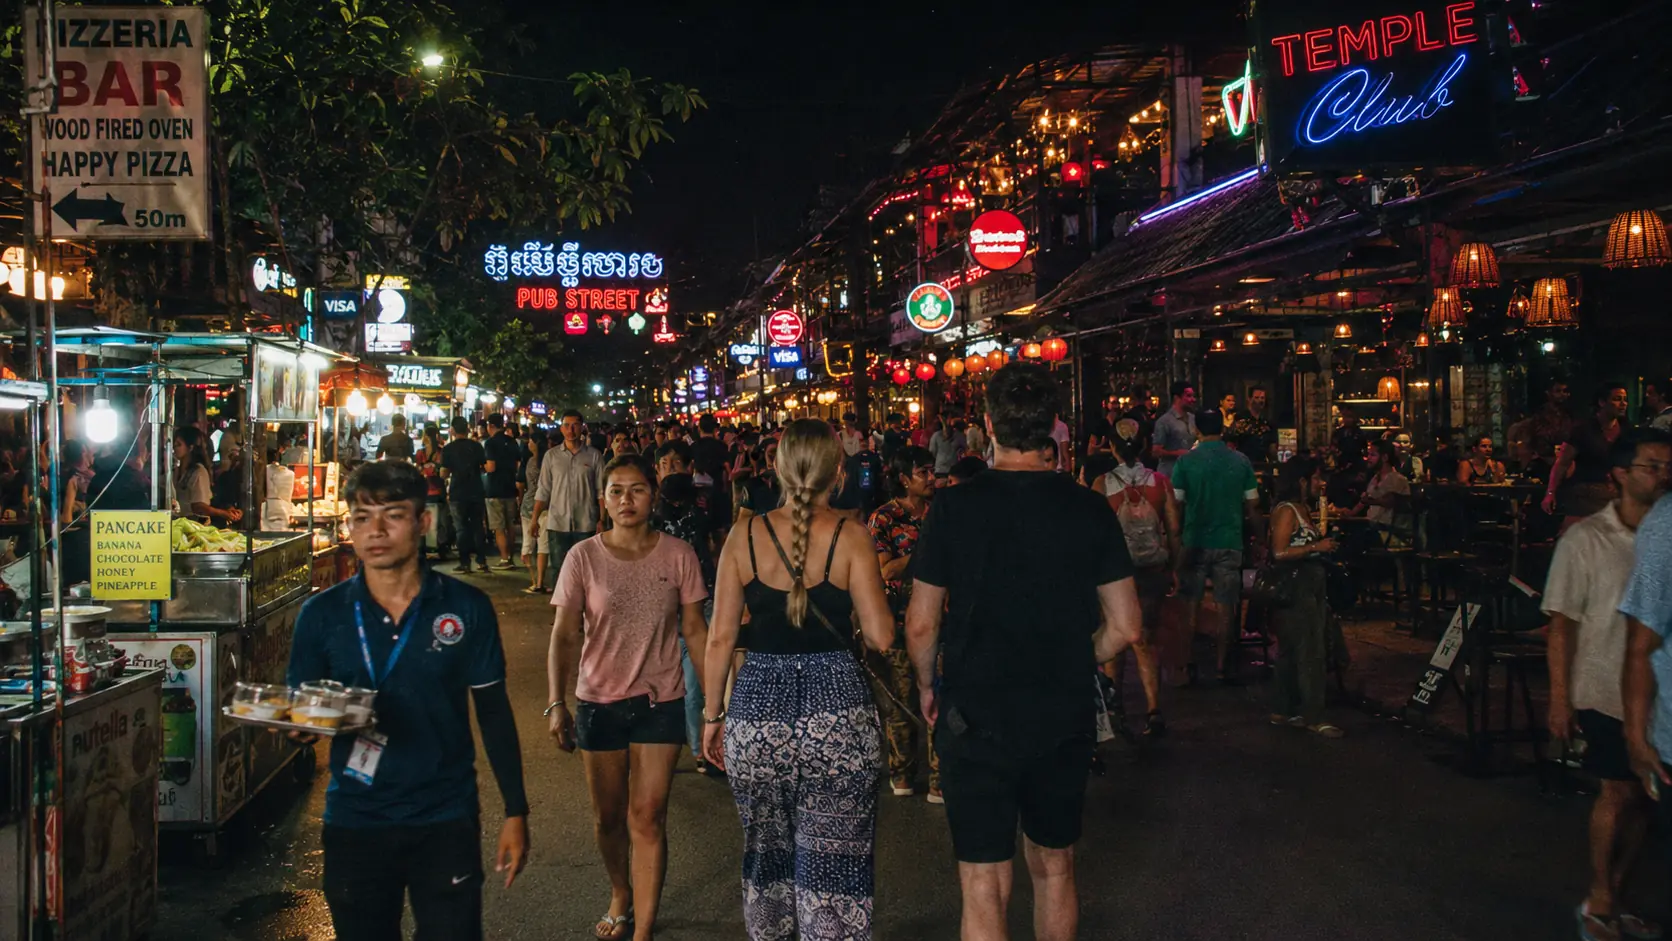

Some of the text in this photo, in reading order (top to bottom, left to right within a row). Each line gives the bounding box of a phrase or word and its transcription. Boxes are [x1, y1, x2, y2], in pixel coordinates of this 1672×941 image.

[37, 19, 193, 48] IZZERIA
[1271, 2, 1478, 76] TEMPLE
[57, 61, 185, 107] BAR
[1300, 53, 1466, 145] Club
[96, 118, 144, 140] FIRED
[149, 118, 193, 140] OVEN
[45, 151, 193, 177] HAPPY PIZZA
[134, 209, 186, 228] 50m
[324, 299, 356, 313] VISA
[516, 287, 559, 310] PUB
[564, 288, 641, 311] STREET
[96, 521, 166, 534] PANCAKE
[97, 541, 142, 550] BANANA
[96, 554, 164, 564] CHOCOLATE
[97, 568, 136, 577] HONEY
[97, 581, 158, 591] PINEAPPLE
